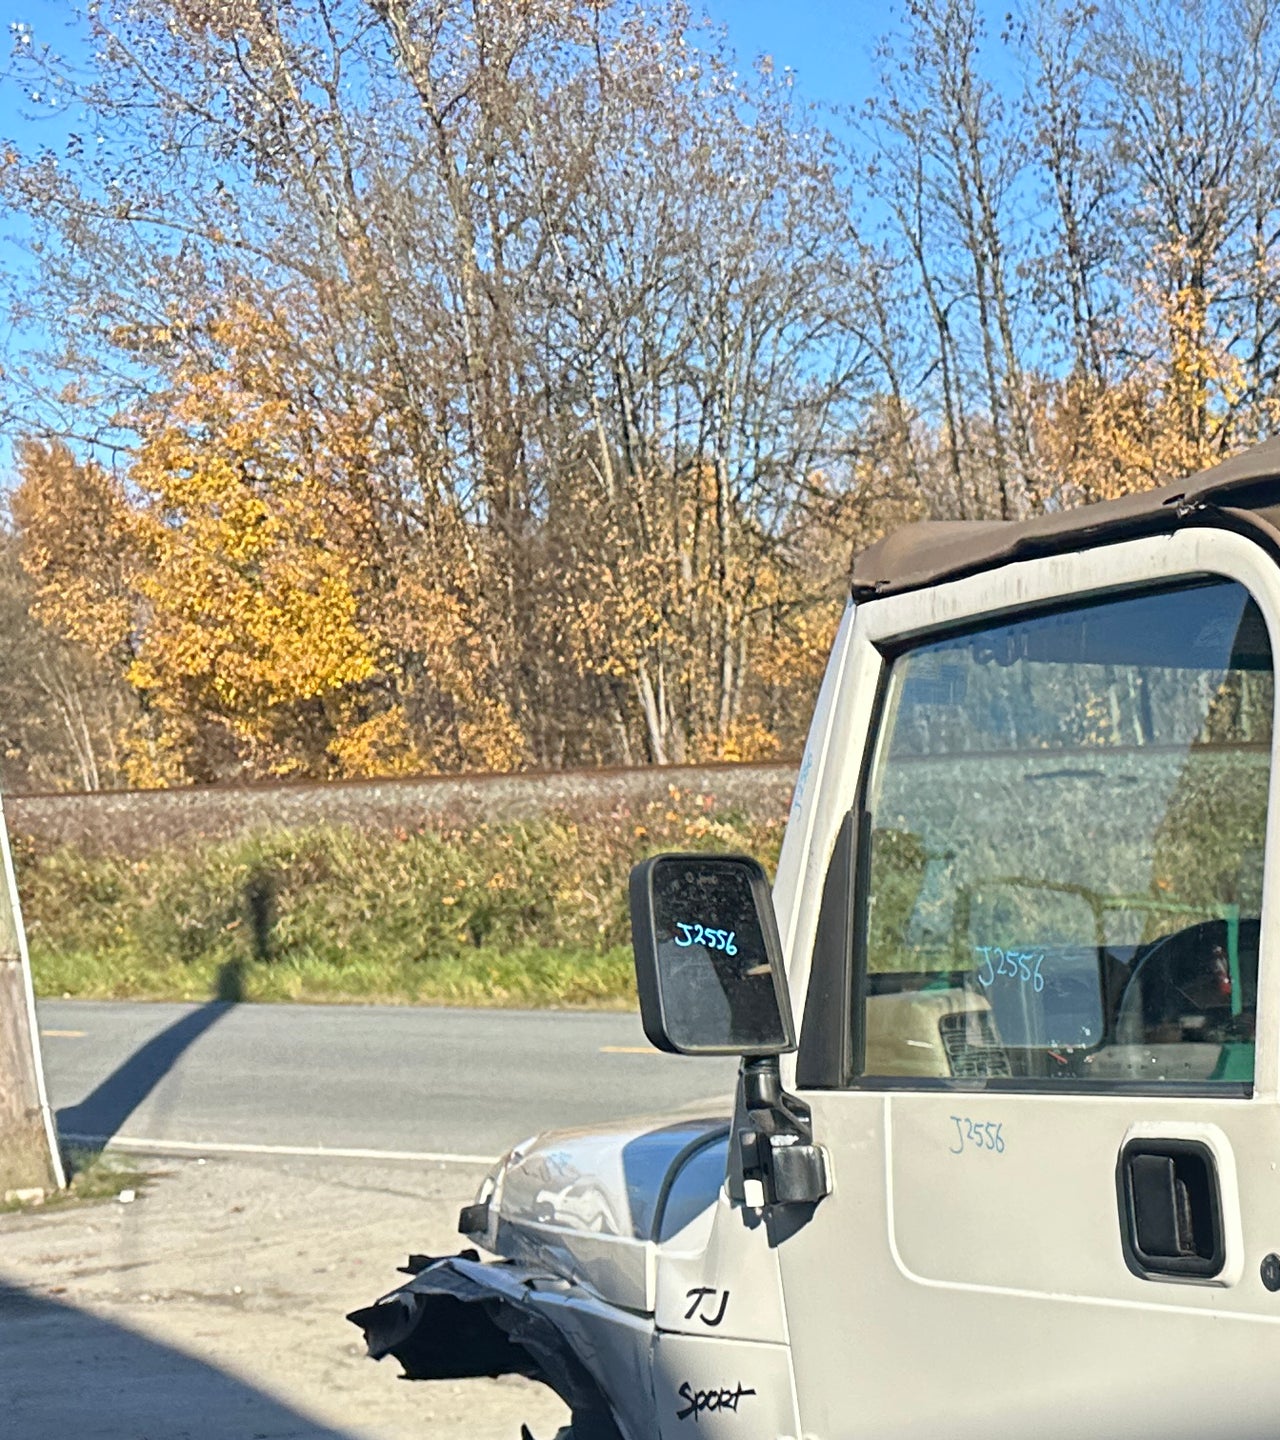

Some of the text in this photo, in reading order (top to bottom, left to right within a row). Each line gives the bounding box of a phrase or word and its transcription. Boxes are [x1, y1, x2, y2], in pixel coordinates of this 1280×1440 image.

[674, 922, 738, 956] J2556
[976, 946, 1045, 993] J2556
[949, 1116, 1005, 1155] J2556
[684, 1287, 730, 1326] TJ
[677, 1381, 756, 1422] Sport
